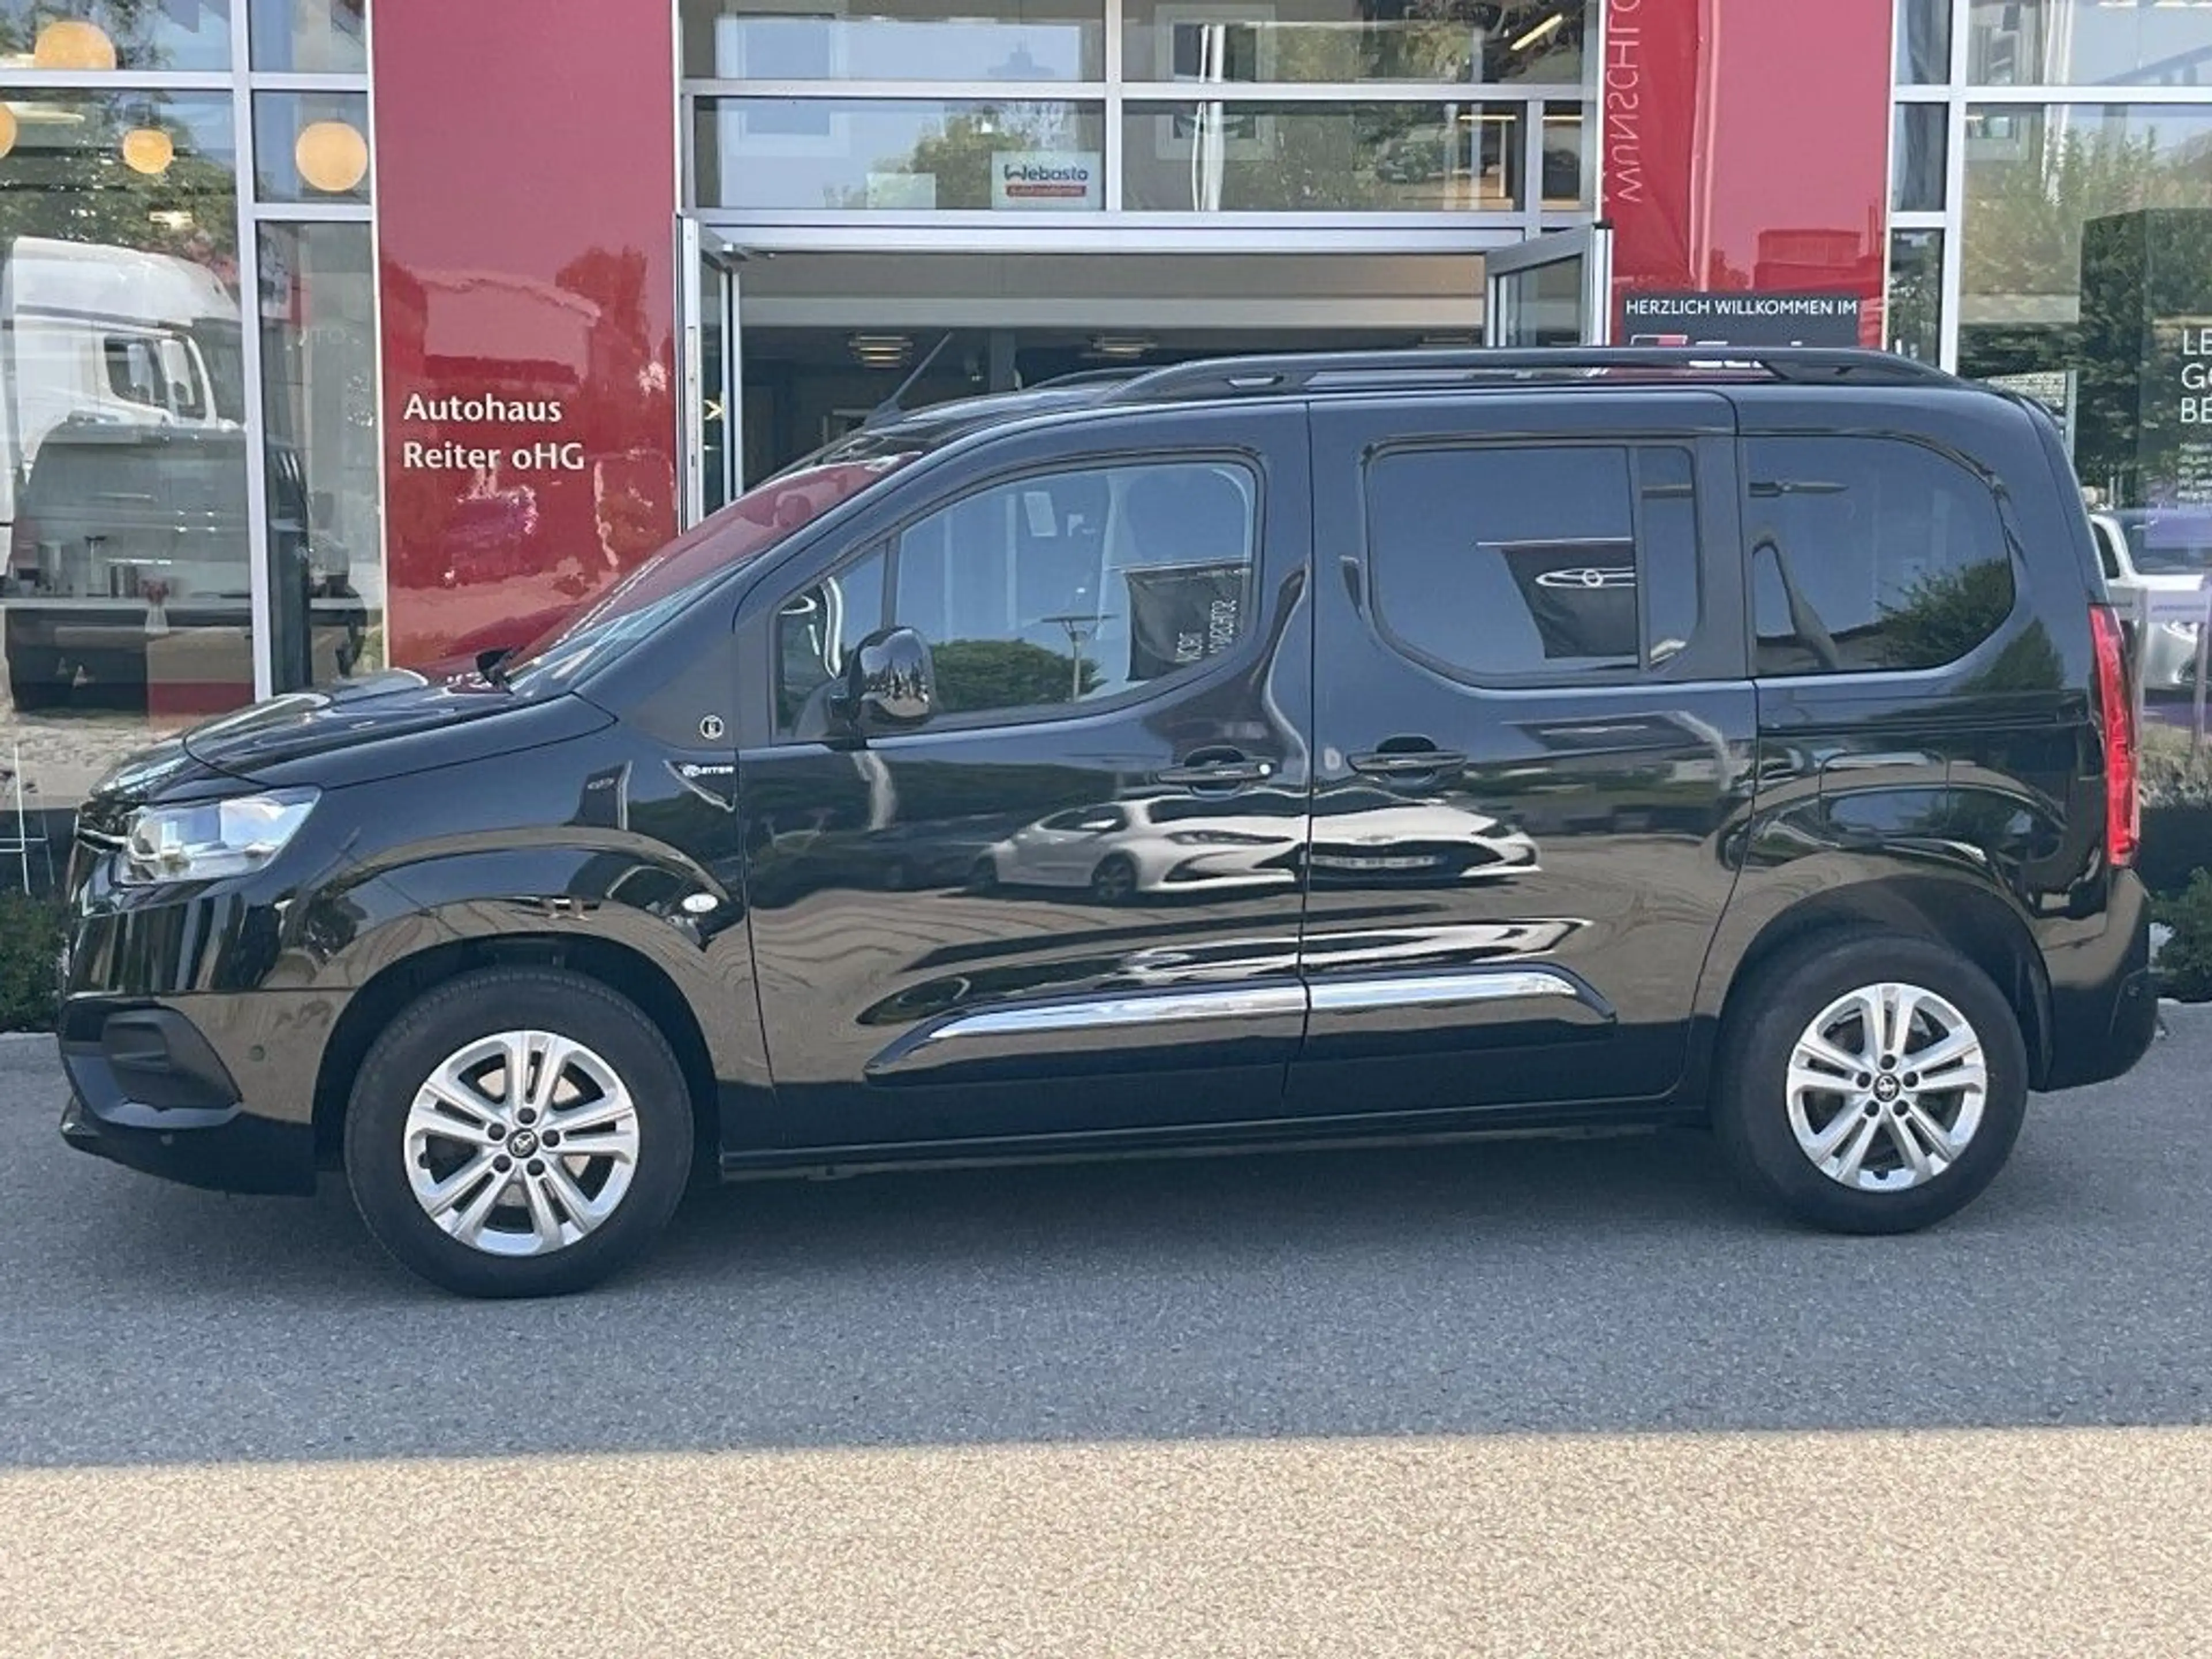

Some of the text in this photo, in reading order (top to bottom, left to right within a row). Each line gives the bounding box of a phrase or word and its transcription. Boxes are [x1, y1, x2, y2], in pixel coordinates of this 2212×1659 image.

[1004, 164, 1089, 180] Webasto
[1626, 300, 1857, 315] HERZLICH WILLKOMMEN IM
[2181, 362, 2212, 389] G
[404, 393, 562, 422] Autohaus
[404, 441, 585, 470] Reiter oHG
